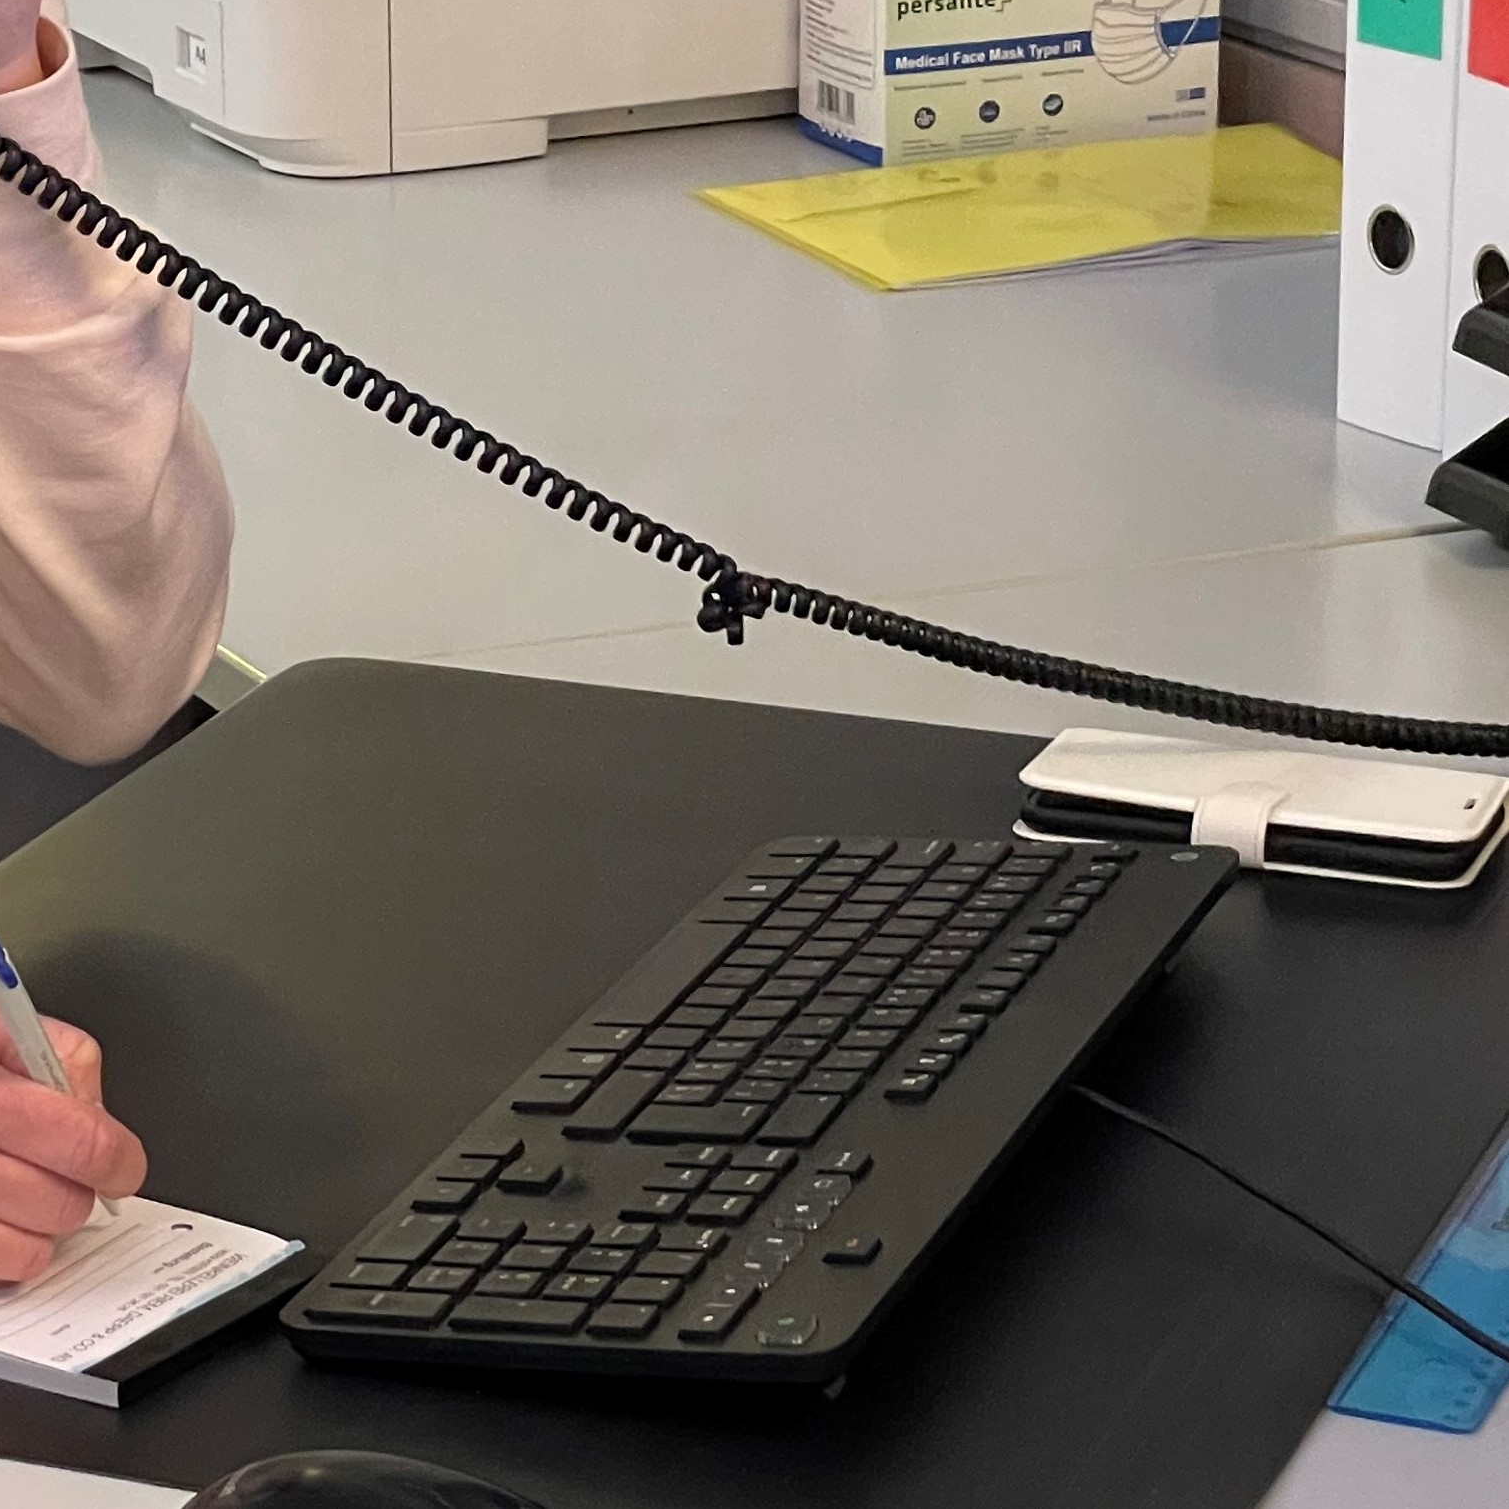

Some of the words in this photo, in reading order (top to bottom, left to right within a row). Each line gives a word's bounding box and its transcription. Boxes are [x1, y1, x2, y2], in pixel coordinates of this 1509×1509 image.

[895, 52, 950, 70] Medical
[953, 51, 986, 66] Face
[989, 46, 1025, 62] Mask
[1028, 43, 1060, 60] Type
[1063, 39, 1082, 54] IIR
